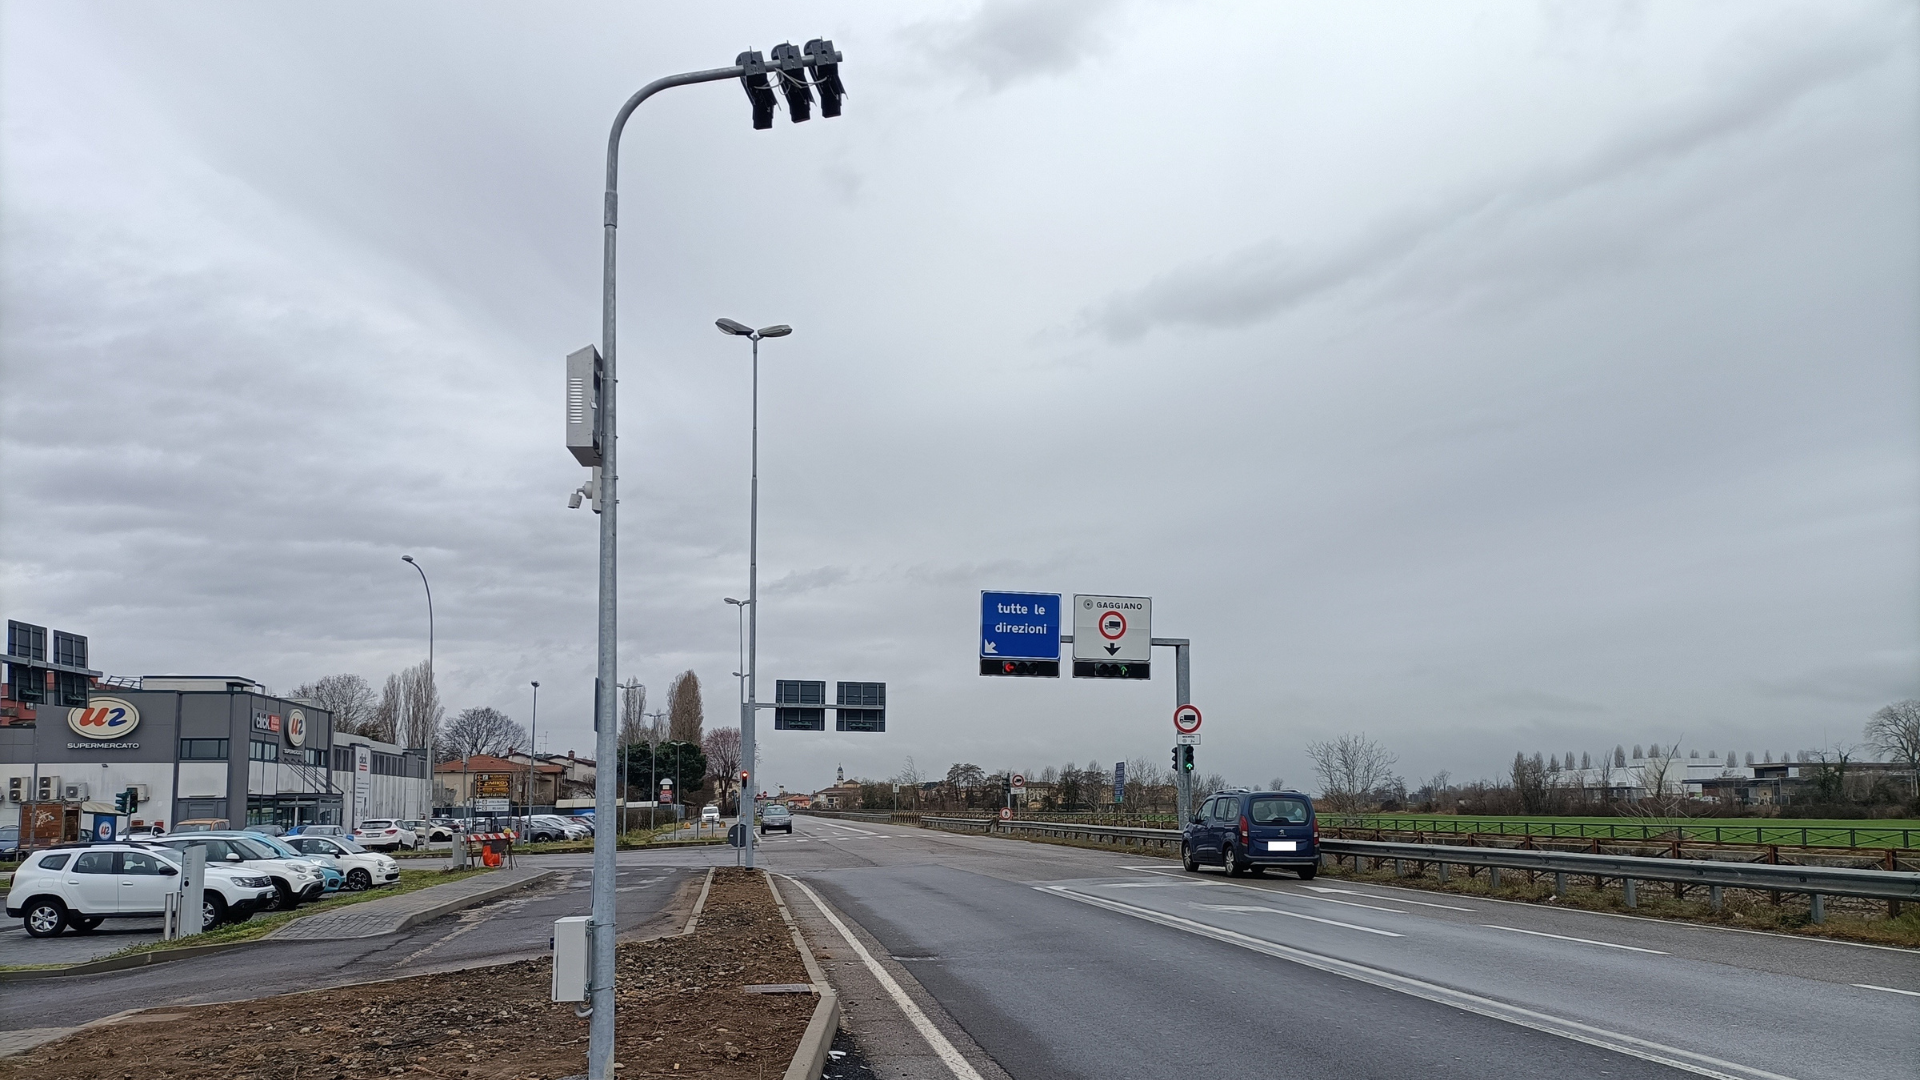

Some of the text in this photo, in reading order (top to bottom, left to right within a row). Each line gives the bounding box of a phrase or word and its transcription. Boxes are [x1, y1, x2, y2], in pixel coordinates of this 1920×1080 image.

[997, 602, 1046, 615] tutte le
[1096, 601, 1143, 610] GAGGIANO
[994, 621, 1048, 635] direzioni
